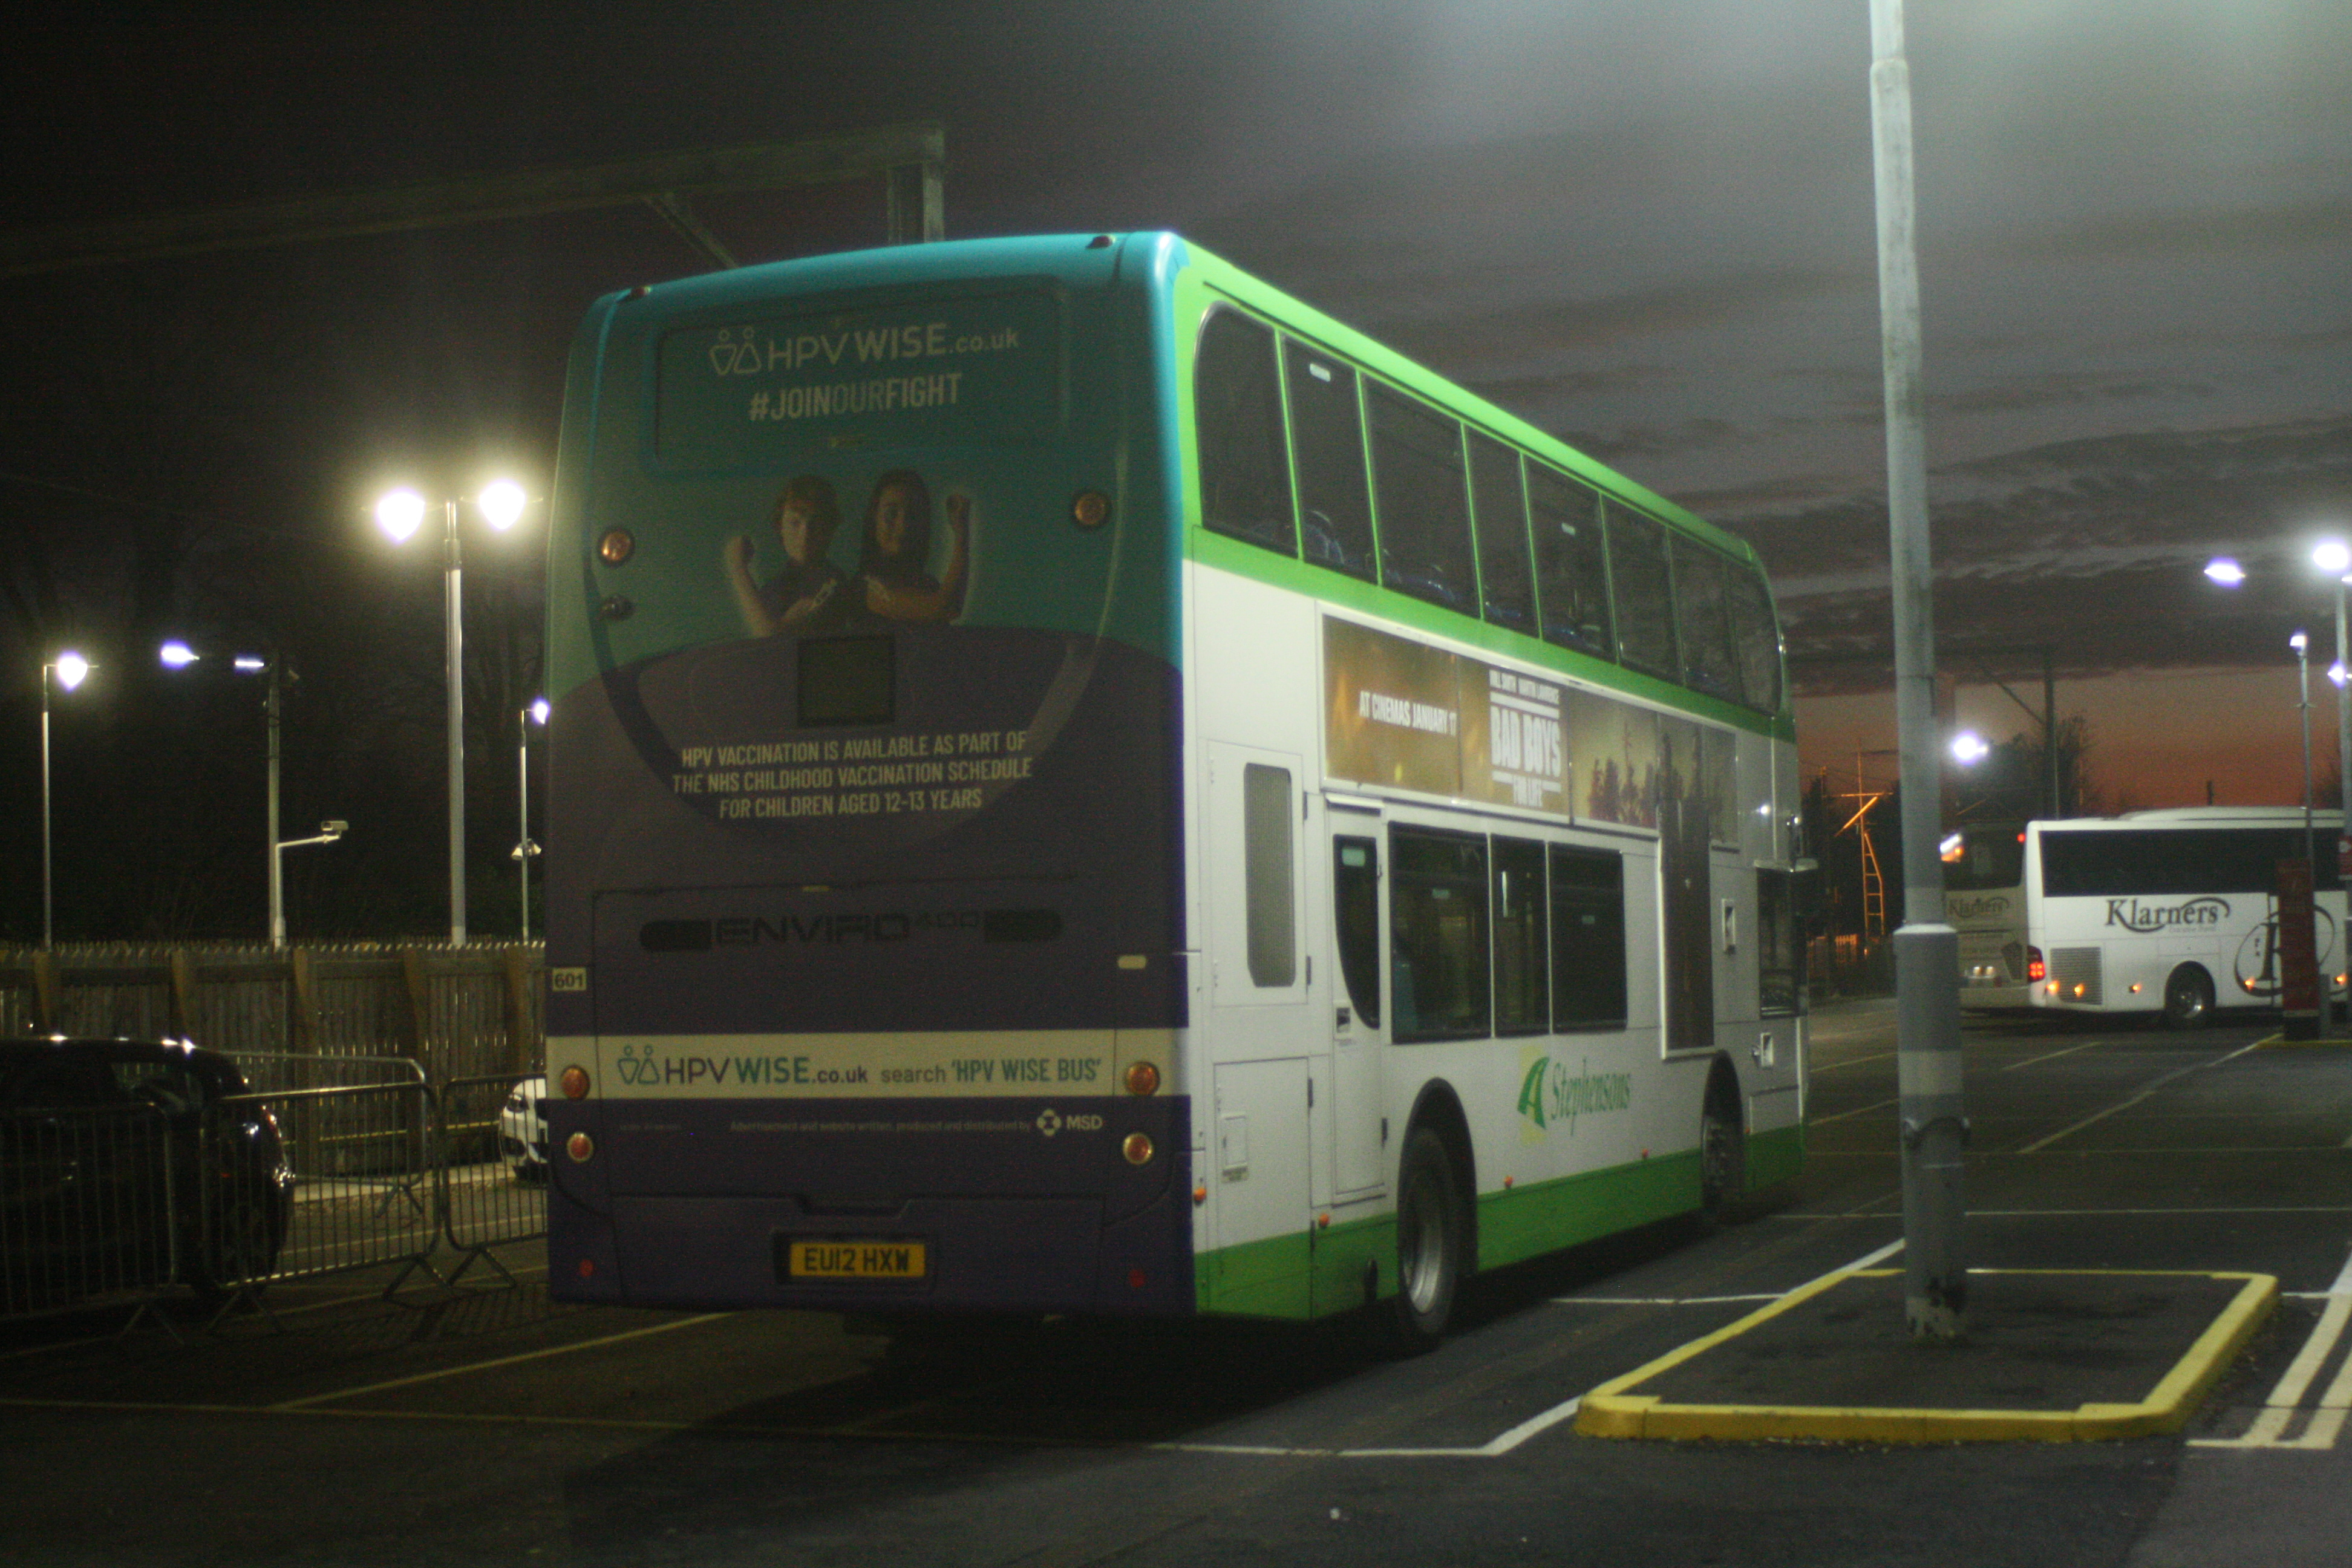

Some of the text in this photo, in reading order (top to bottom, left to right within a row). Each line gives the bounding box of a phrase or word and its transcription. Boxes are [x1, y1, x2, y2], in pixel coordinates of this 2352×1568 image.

[749, 372, 962, 421] #JOINOURFIGHT
[1359, 690, 1370, 718] AT
[1371, 693, 1411, 727] CINEMAS
[1412, 702, 1448, 734] JANUARY
[682, 730, 1027, 768] HPV VACCINATION IS AVAILABLE AS PART OF
[1490, 705, 1561, 777] BAD BOYS
[672, 757, 1034, 795] THE NHS CHILDHOOD VACCINATION SCHEDULE
[719, 788, 983, 819] FOR CHILDREN AGED 12-13 YEARS
[2105, 897, 2230, 932] Klarners
[555, 973, 583, 988] 601
[881, 1065, 947, 1083] search
[1001, 1057, 1050, 1082] WISE
[1551, 1056, 1632, 1136] Stephensons
[1066, 1114, 1103, 1131] MSD
[805, 1247, 909, 1272] EU12 HXW
